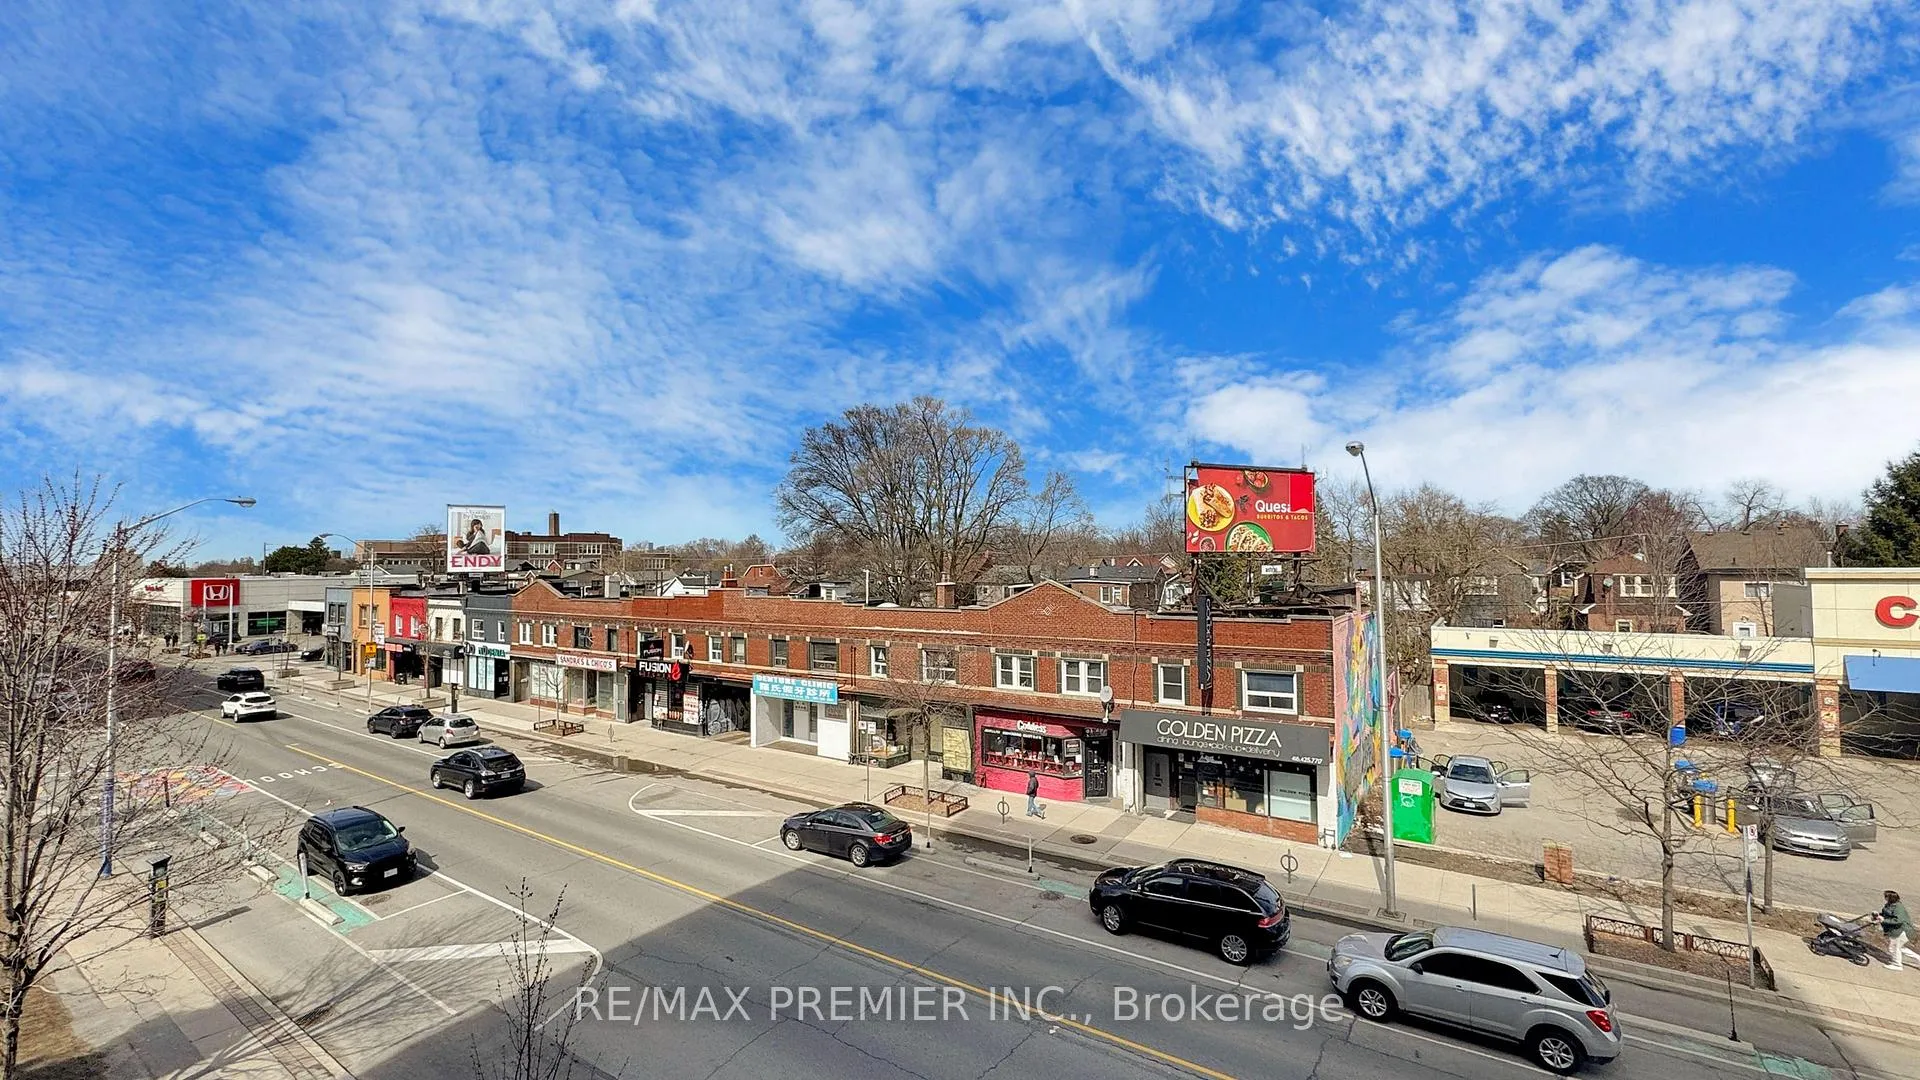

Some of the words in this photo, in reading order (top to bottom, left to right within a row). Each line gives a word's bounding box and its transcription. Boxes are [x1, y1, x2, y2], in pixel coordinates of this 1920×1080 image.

[450, 555, 502, 568] ENDY
[639, 661, 672, 674] FUSION
[755, 674, 797, 685] DENTURE
[800, 680, 834, 690] CLINIC
[1157, 719, 1226, 741] GOLDEN
[1231, 726, 1282, 748] PIZZA
[1157, 736, 1178, 745] dining
